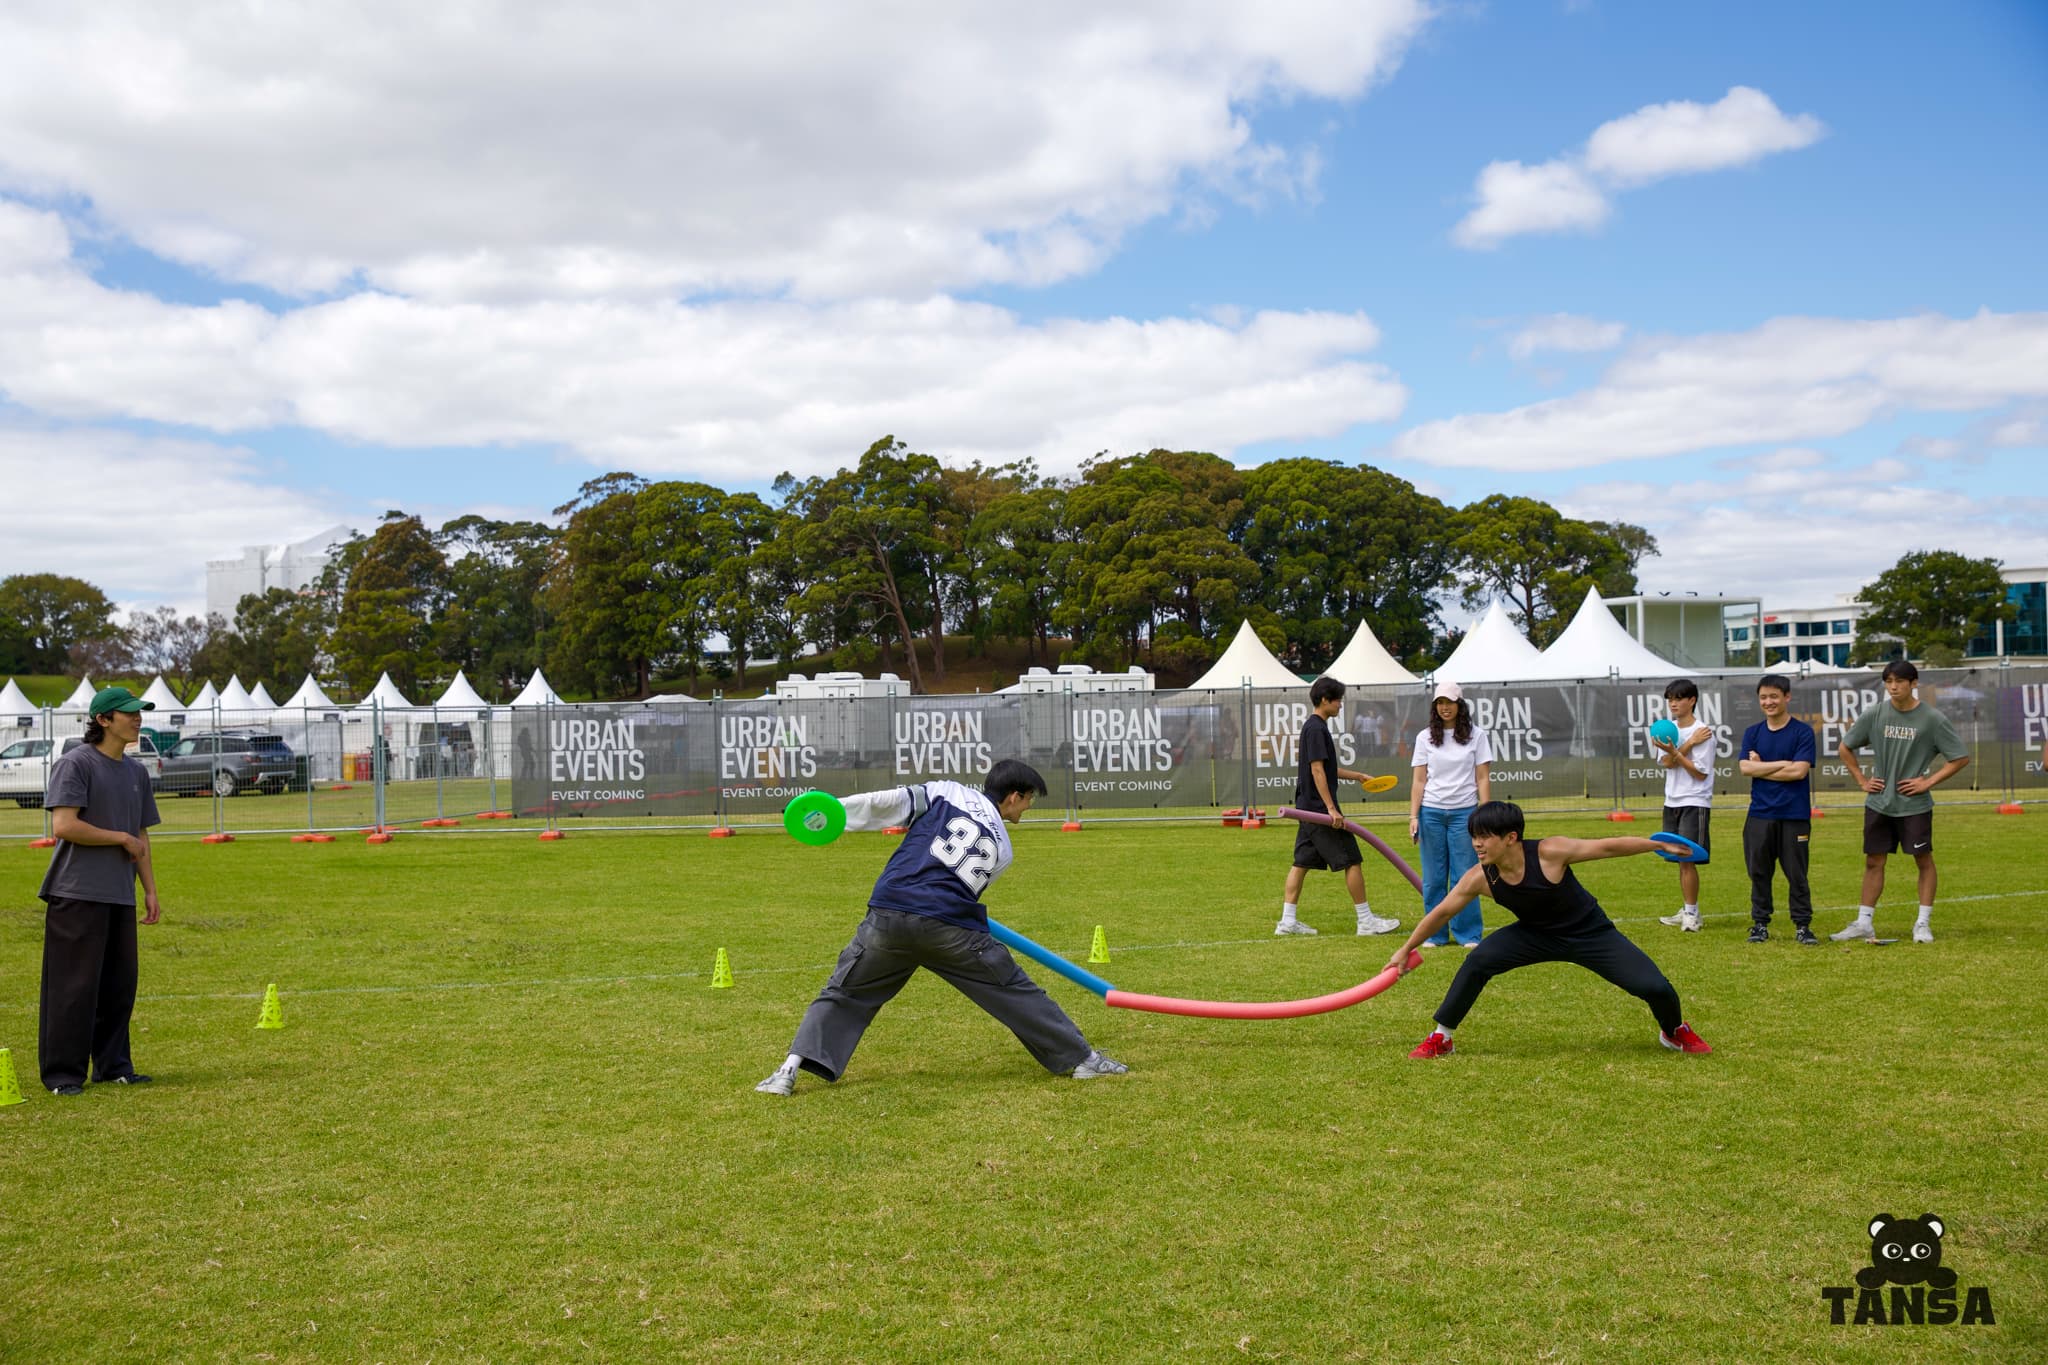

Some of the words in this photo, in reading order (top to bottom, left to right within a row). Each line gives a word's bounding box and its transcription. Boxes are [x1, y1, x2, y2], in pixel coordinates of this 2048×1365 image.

[1073, 708, 1162, 741] URBAN
[1255, 703, 1345, 736] URBN
[1626, 693, 1722, 727] URN
[551, 719, 635, 751] URBAN
[721, 715, 807, 748] URBAN
[895, 711, 982, 743] URBAN
[551, 749, 645, 782] EVENTS
[722, 746, 817, 779] EVENTS
[896, 742, 992, 774] EVENTS
[1074, 739, 1173, 773] EVENTS
[1256, 733, 1356, 768] EVES
[1074, 781, 1116, 792] EVENT
[1118, 780, 1173, 792] COMING
[1257, 776, 1298, 787] EVENT
[1488, 770, 1543, 782] COMING
[1822, 765, 1868, 776] EVET
[552, 790, 590, 800] EVENT
[593, 789, 645, 800] COMING
[722, 787, 761, 798] EVENT
[930, 816, 998, 896] 32
